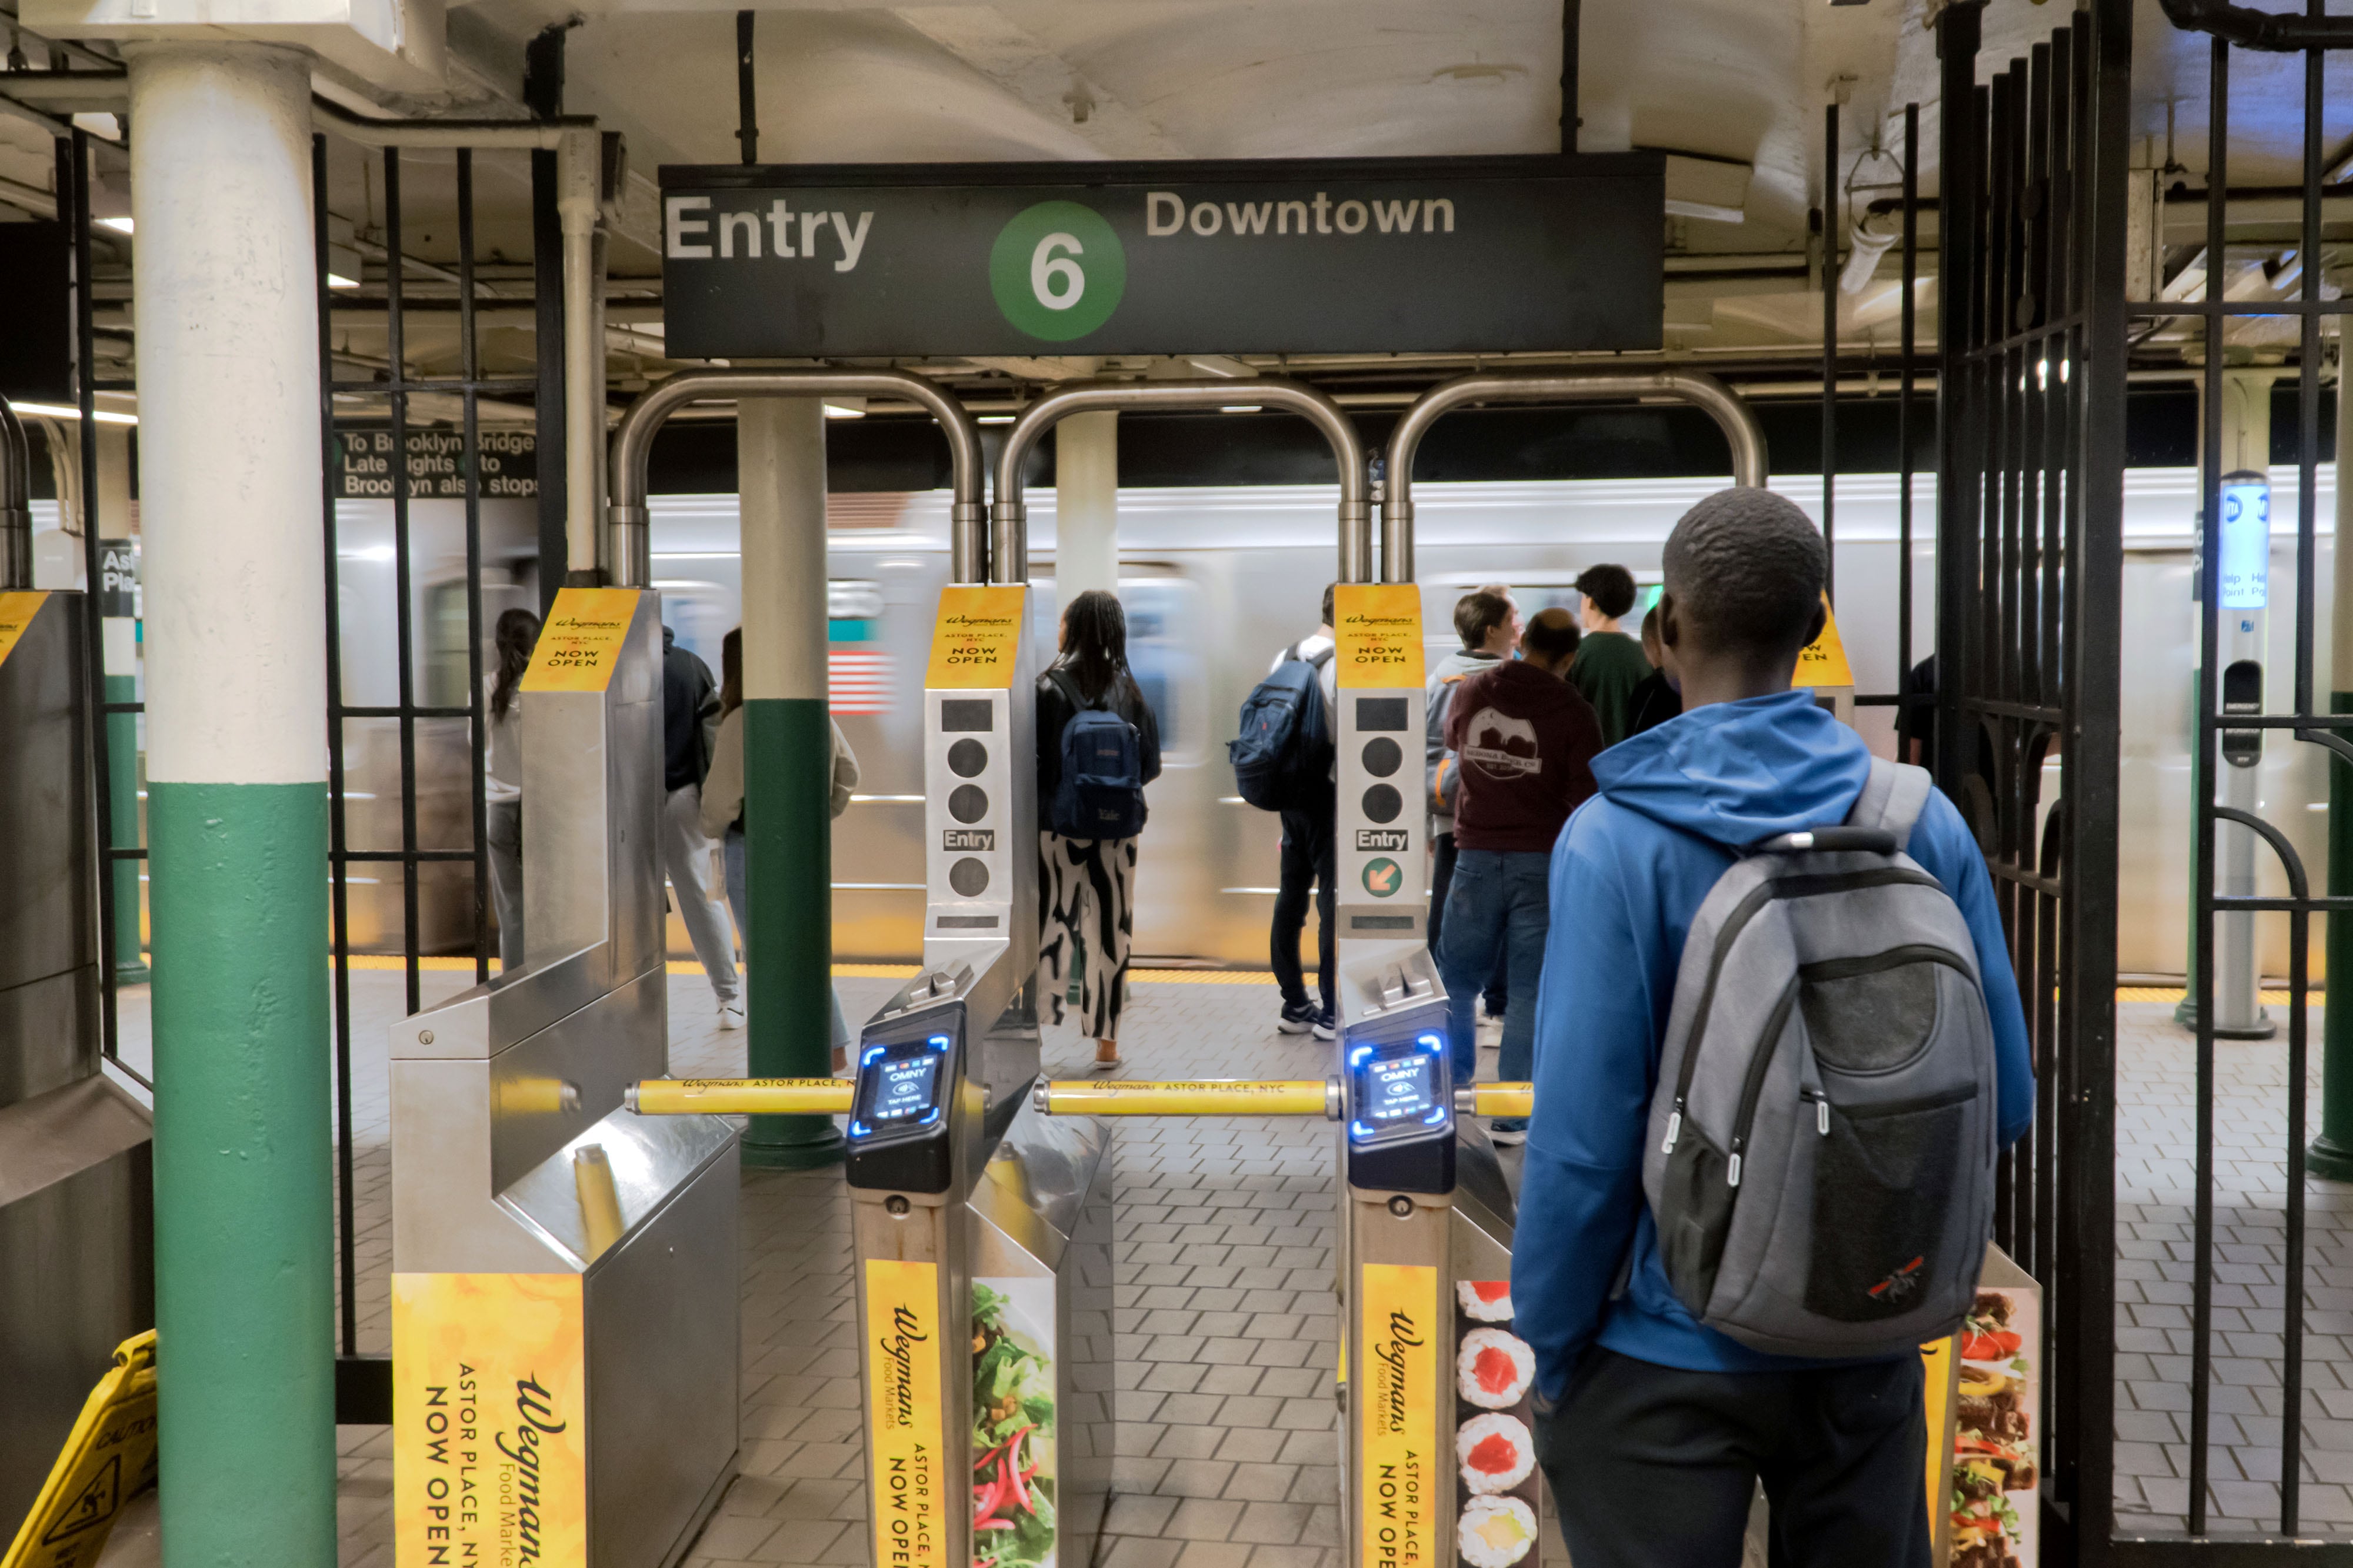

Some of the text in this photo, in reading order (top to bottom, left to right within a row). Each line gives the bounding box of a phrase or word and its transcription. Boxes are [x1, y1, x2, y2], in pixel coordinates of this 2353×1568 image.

[665, 196, 874, 273] Entry
[1146, 191, 1455, 236] Downtown
[1031, 232, 1085, 310] 6
[344, 433, 368, 452] To
[345, 454, 500, 476] Late ights to
[944, 831, 993, 850] Entry
[1357, 831, 1407, 850] Entry
[682, 1079, 745, 1094] Wegmans
[799, 1079, 841, 1088] PLACE,
[889, 1067, 927, 1082] OMNY
[1091, 1080, 1285, 1097] Wegmans ASTOR PLACE, NYC
[1381, 1067, 1420, 1082] OMNY
[459, 1362, 477, 1440] ASTOR
[881, 1303, 928, 1428] Wegmans
[884, 1356, 895, 1430] Food Markets
[1375, 1307, 1424, 1435] Wegmans
[1377, 1363, 1389, 1437] Food Markets
[426, 1386, 450, 1565] NOW OPEN
[456, 1452, 478, 1531] PLACE,
[914, 1443, 929, 1496] ASTOR
[499, 1463, 517, 1568] Food Marke
[889, 1457, 909, 1568] NOW OPE
[915, 1503, 930, 1557] PLACE,
[1379, 1464, 1397, 1568] NOW OPE
[1402, 1450, 1418, 1566] ASTOR PLACE,
